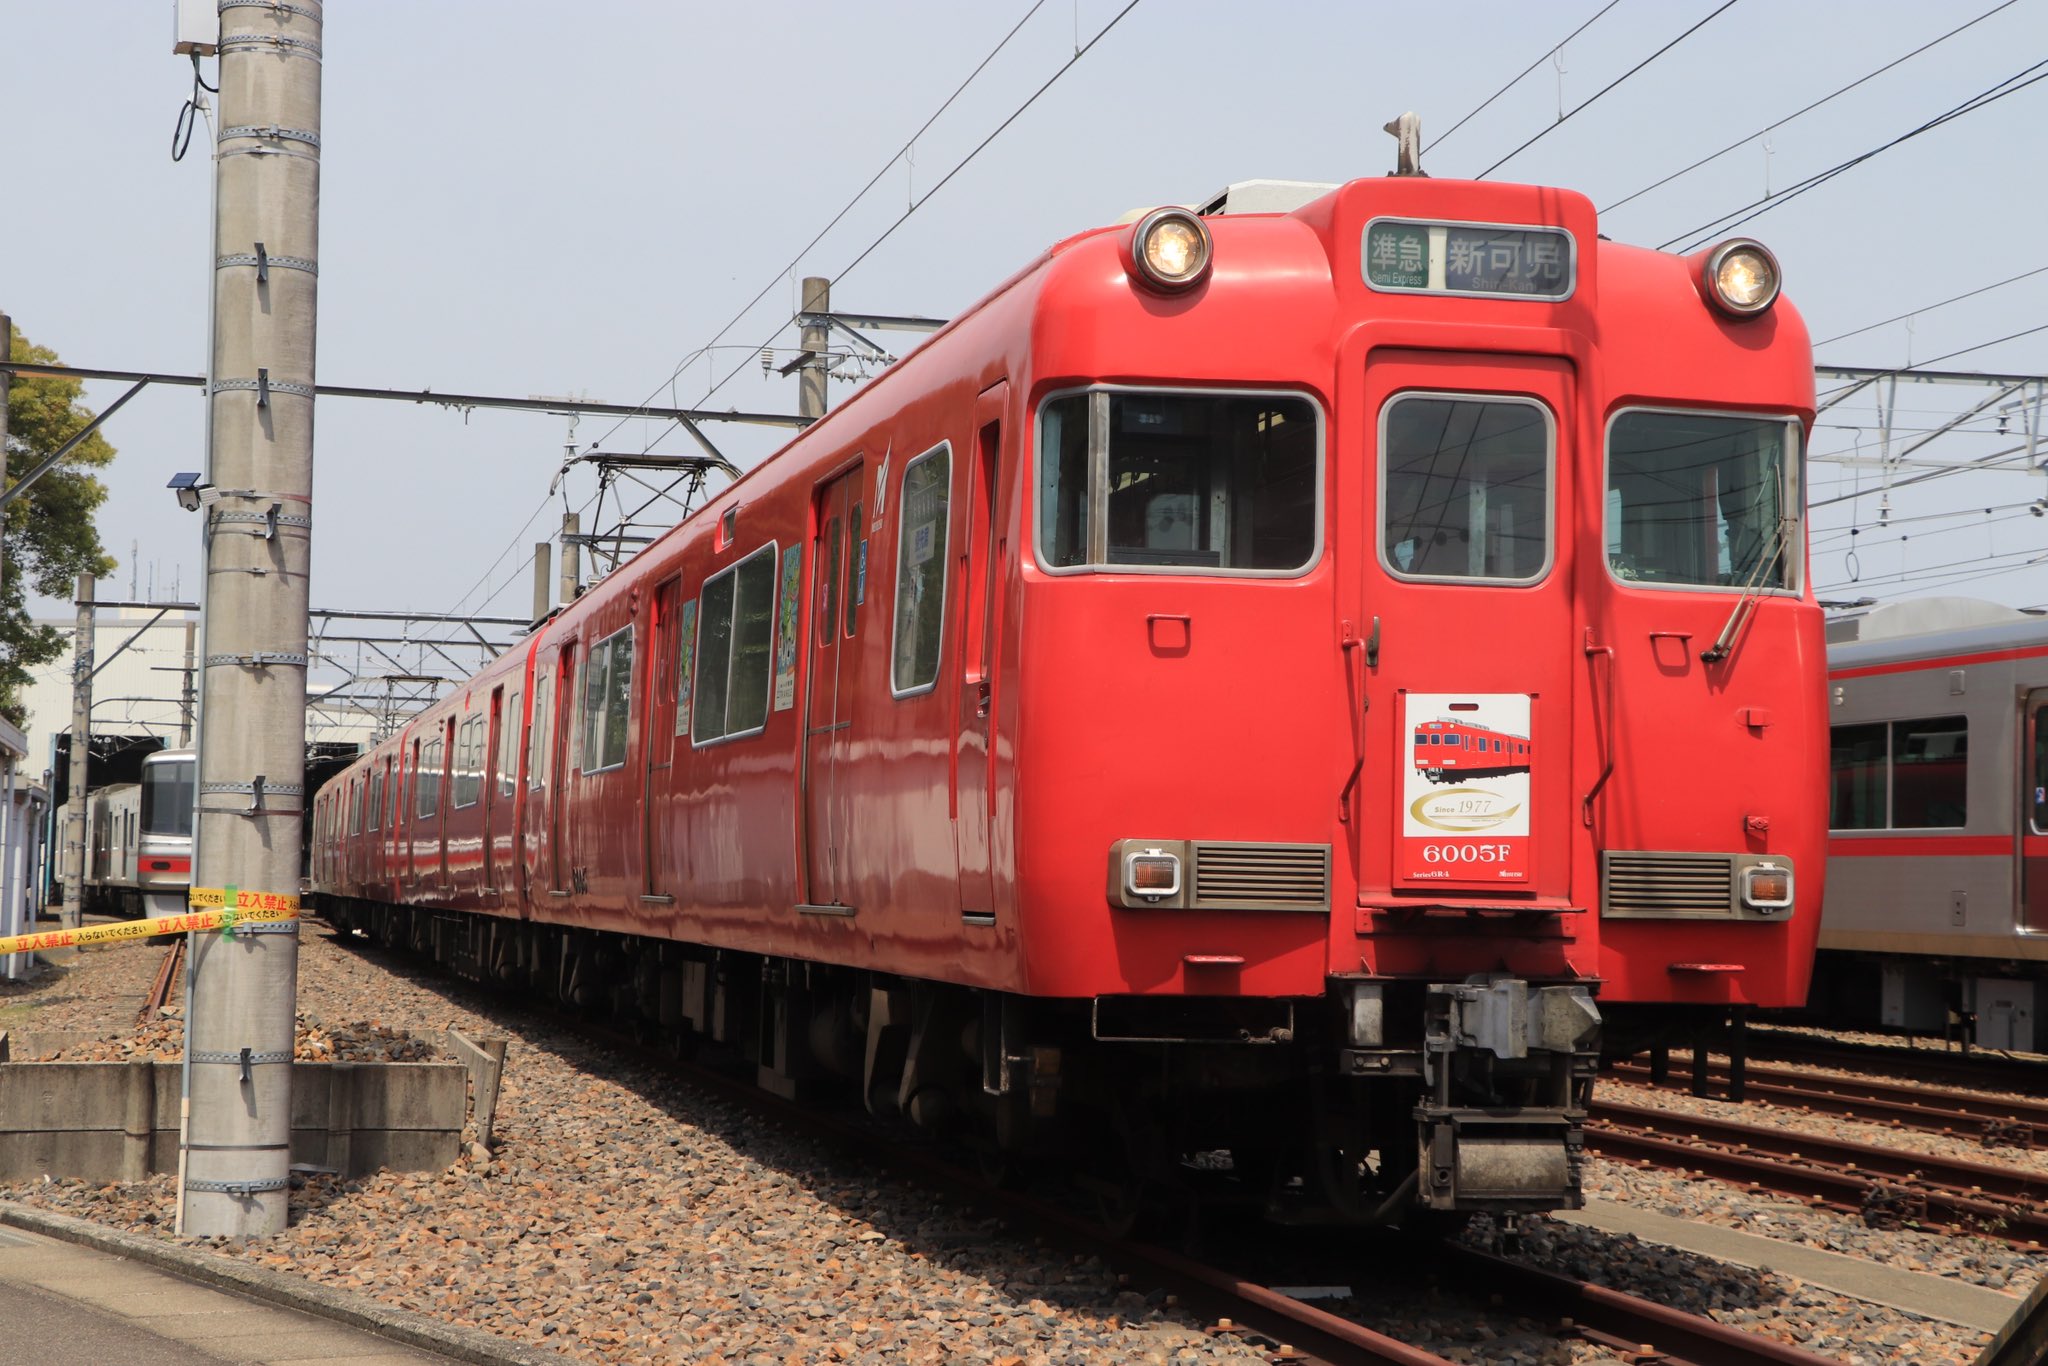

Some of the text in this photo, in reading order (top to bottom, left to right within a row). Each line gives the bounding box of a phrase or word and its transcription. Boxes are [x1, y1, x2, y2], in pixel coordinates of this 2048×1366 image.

[1372, 233, 1422, 272] 準急
[1449, 237, 1562, 280] 新可児
[1372, 271, 1422, 286] Semi Express
[1458, 800, 1492, 813] 1977
[1423, 844, 1511, 863] 6005F
[237, 892, 287, 911] 立入禁止
[16, 932, 74, 952] 立入禁止
[77, 925, 147, 942] 入らないでください
[157, 913, 214, 934] 立入禁止
